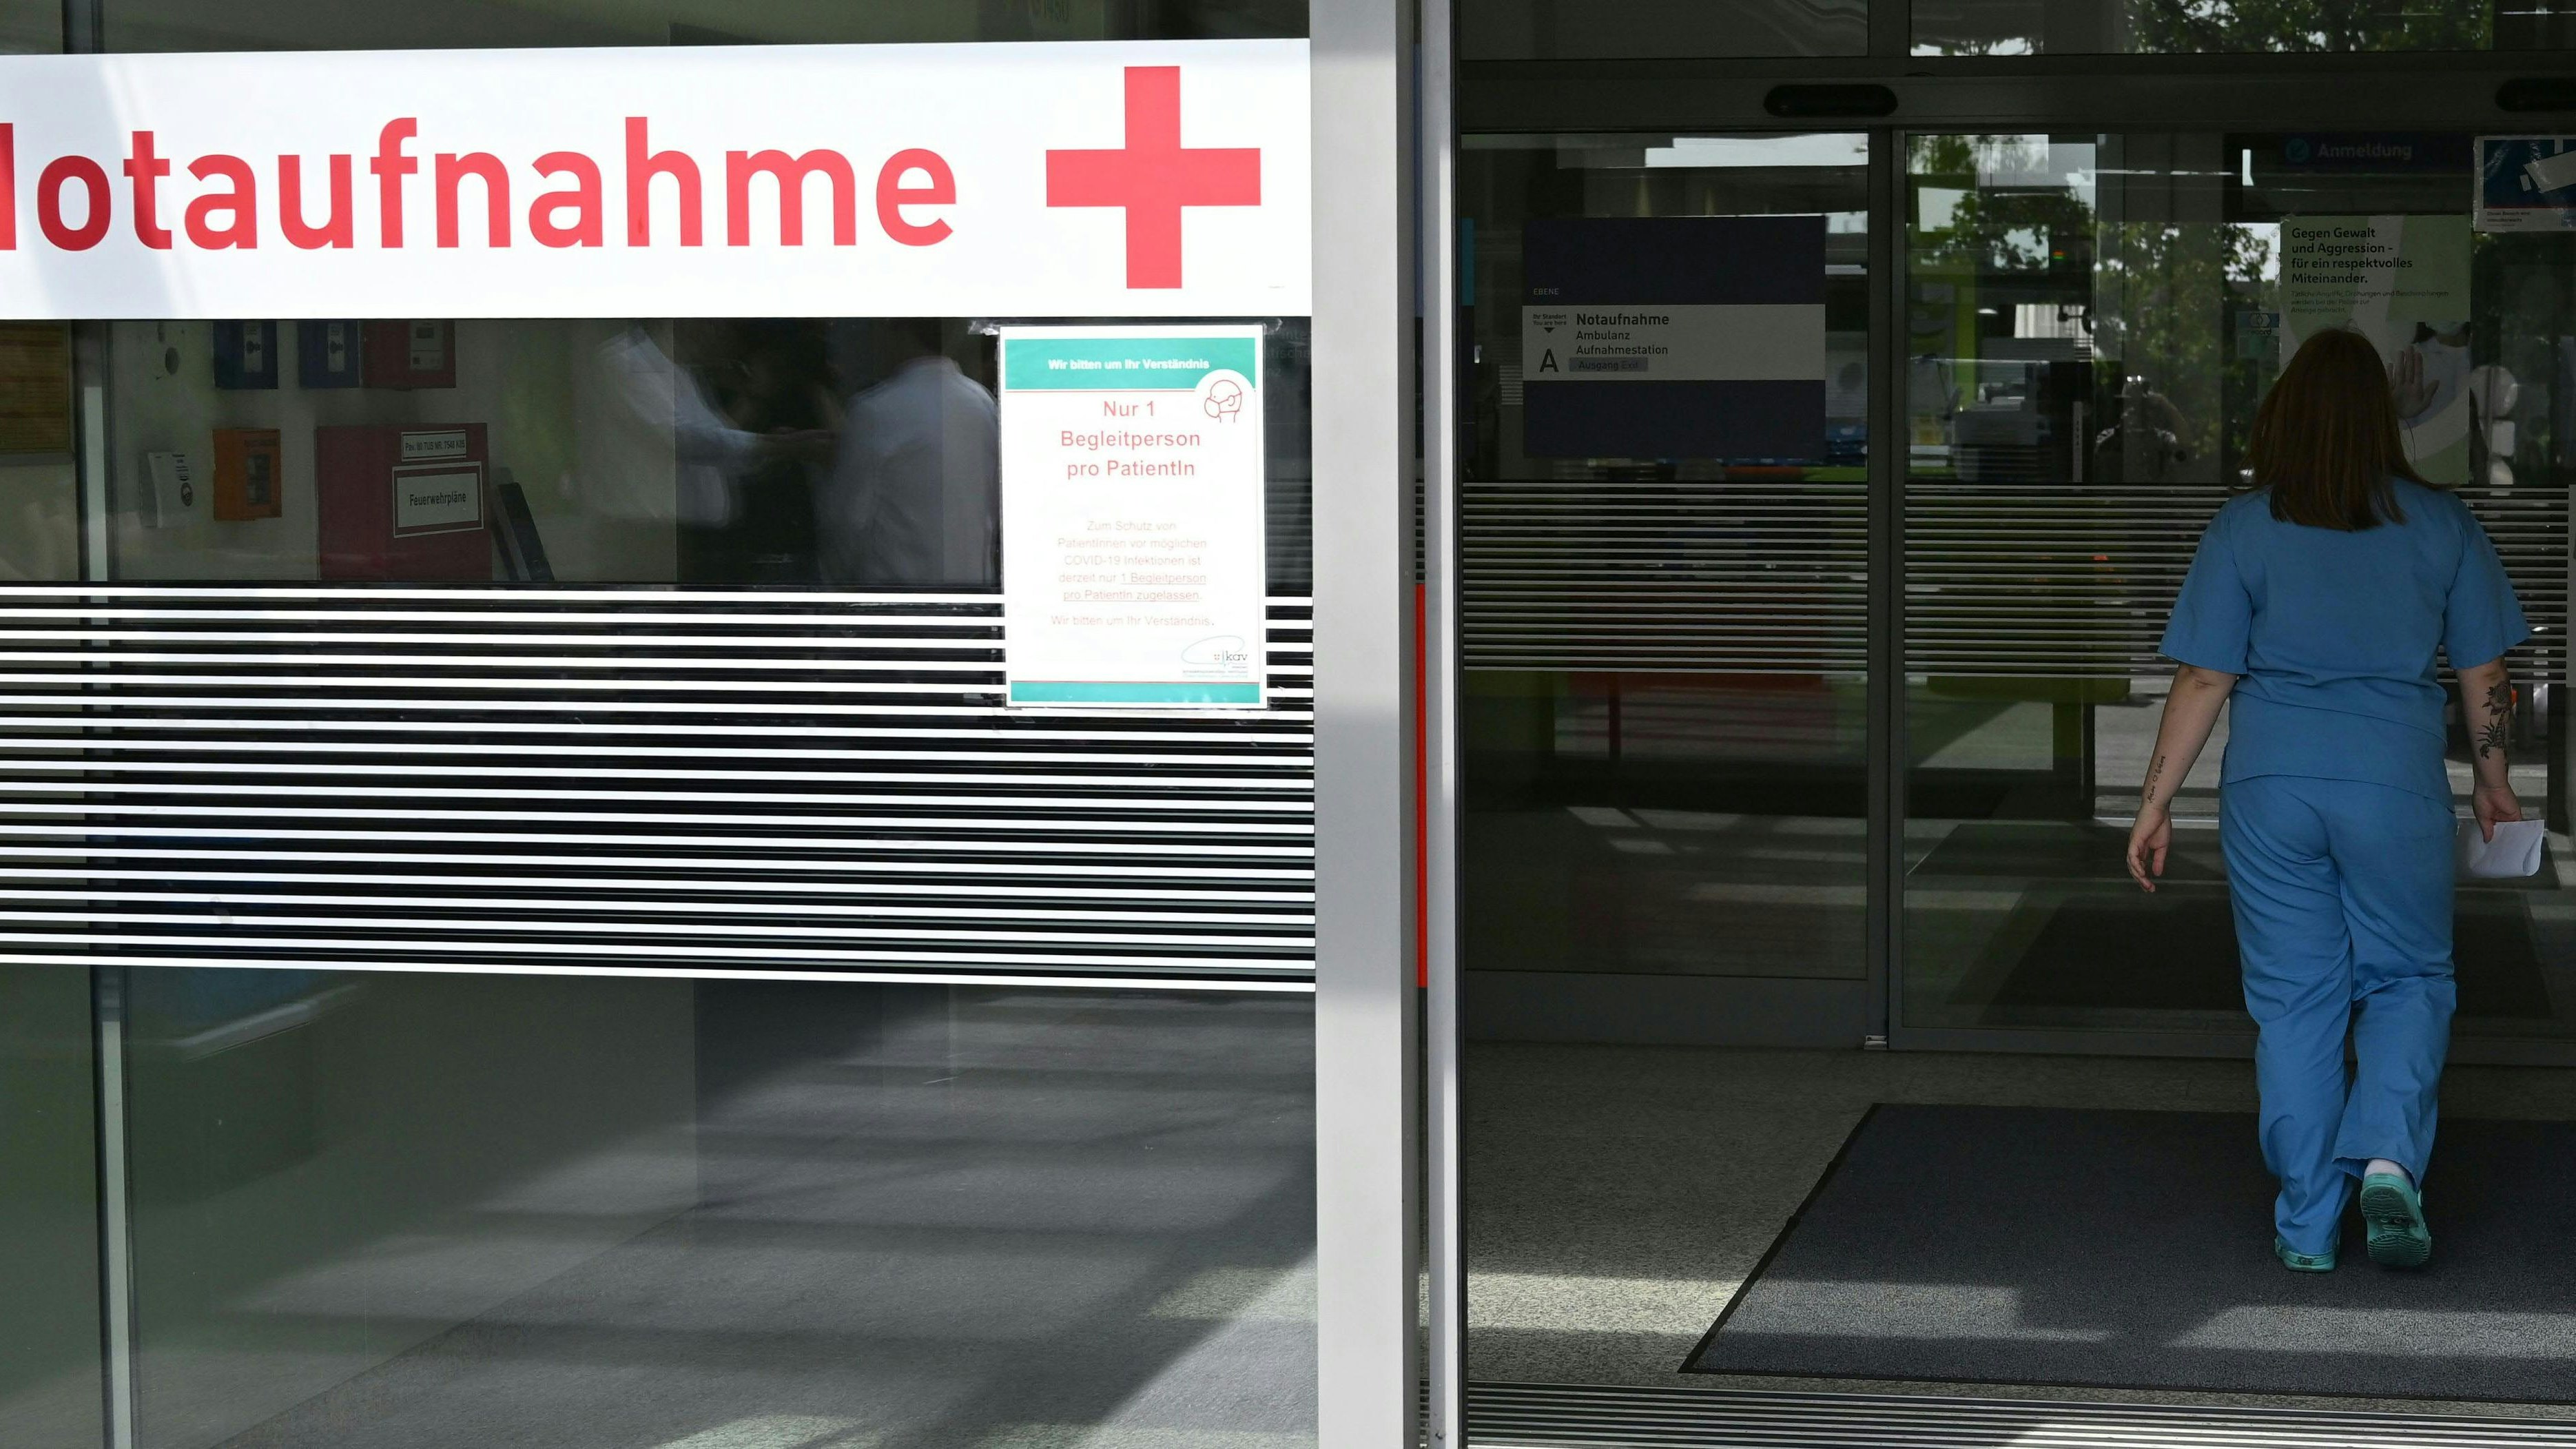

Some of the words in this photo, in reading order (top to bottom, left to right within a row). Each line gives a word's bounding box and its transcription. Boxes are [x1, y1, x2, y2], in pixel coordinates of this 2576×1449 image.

[2316, 142, 2412, 160] Anmeldung
[0, 116, 956, 251] otaufnahme
[2291, 228, 2331, 241] Gegen
[2333, 227, 2376, 238] Gewalt
[2291, 243, 2314, 254] und
[2317, 243, 2385, 256] Aggression
[2291, 258, 2309, 268] für
[2311, 258, 2329, 268] ein
[2332, 258, 2413, 271] respektvolles
[2291, 273, 2368, 284] Miteinander.
[1533, 287, 1560, 296] EBENE
[1576, 313, 1670, 326] Notaufnahme
[1576, 331, 1631, 340] Ambulanz
[1576, 345, 1669, 355] Aufnahmestation
[1048, 359, 1067, 370] Wir
[1070, 359, 1102, 370] bitten
[1104, 361, 1122, 370] um
[1124, 359, 1140, 370] Ihr
[1142, 358, 1210, 370] Verständnis
[1538, 348, 1559, 373] A
[1578, 361, 1619, 371] Ausgang
[1621, 361, 1638, 369] Exit
[1104, 400, 1139, 417] Nur
[1146, 400, 1155, 417] 1
[1061, 431, 1201, 451] Begleitperson
[1067, 464, 1100, 480] pro
[1107, 460, 1195, 477] PatientIn
[409, 491, 466, 506] Feuerwehrpläne
[1086, 521, 1112, 531] Zum
[1115, 521, 1153, 531] Schutz
[1155, 523, 1177, 531] von
[1130, 539, 1146, 548] vor
[1150, 537, 1207, 551] möglichen
[1064, 555, 1121, 566] COVID-19
[1124, 555, 1185, 566] Infektionen
[1189, 555, 1202, 566] ist
[1058, 573, 1095, 583] derzeit
[1099, 575, 1117, 583] nur
[1120, 573, 1126, 583] 1
[1130, 573, 1207, 585] Begleitperson
[1063, 592, 1082, 602] pro
[1084, 590, 1133, 600] PatientIn
[1136, 590, 1202, 602] zugelassen.
[1051, 615, 1071, 626] Wir
[1072, 615, 1103, 626] bitten
[1106, 617, 1124, 626] um
[1126, 615, 1142, 626] Ihr
[1144, 615, 1215, 626] Verständnis.
